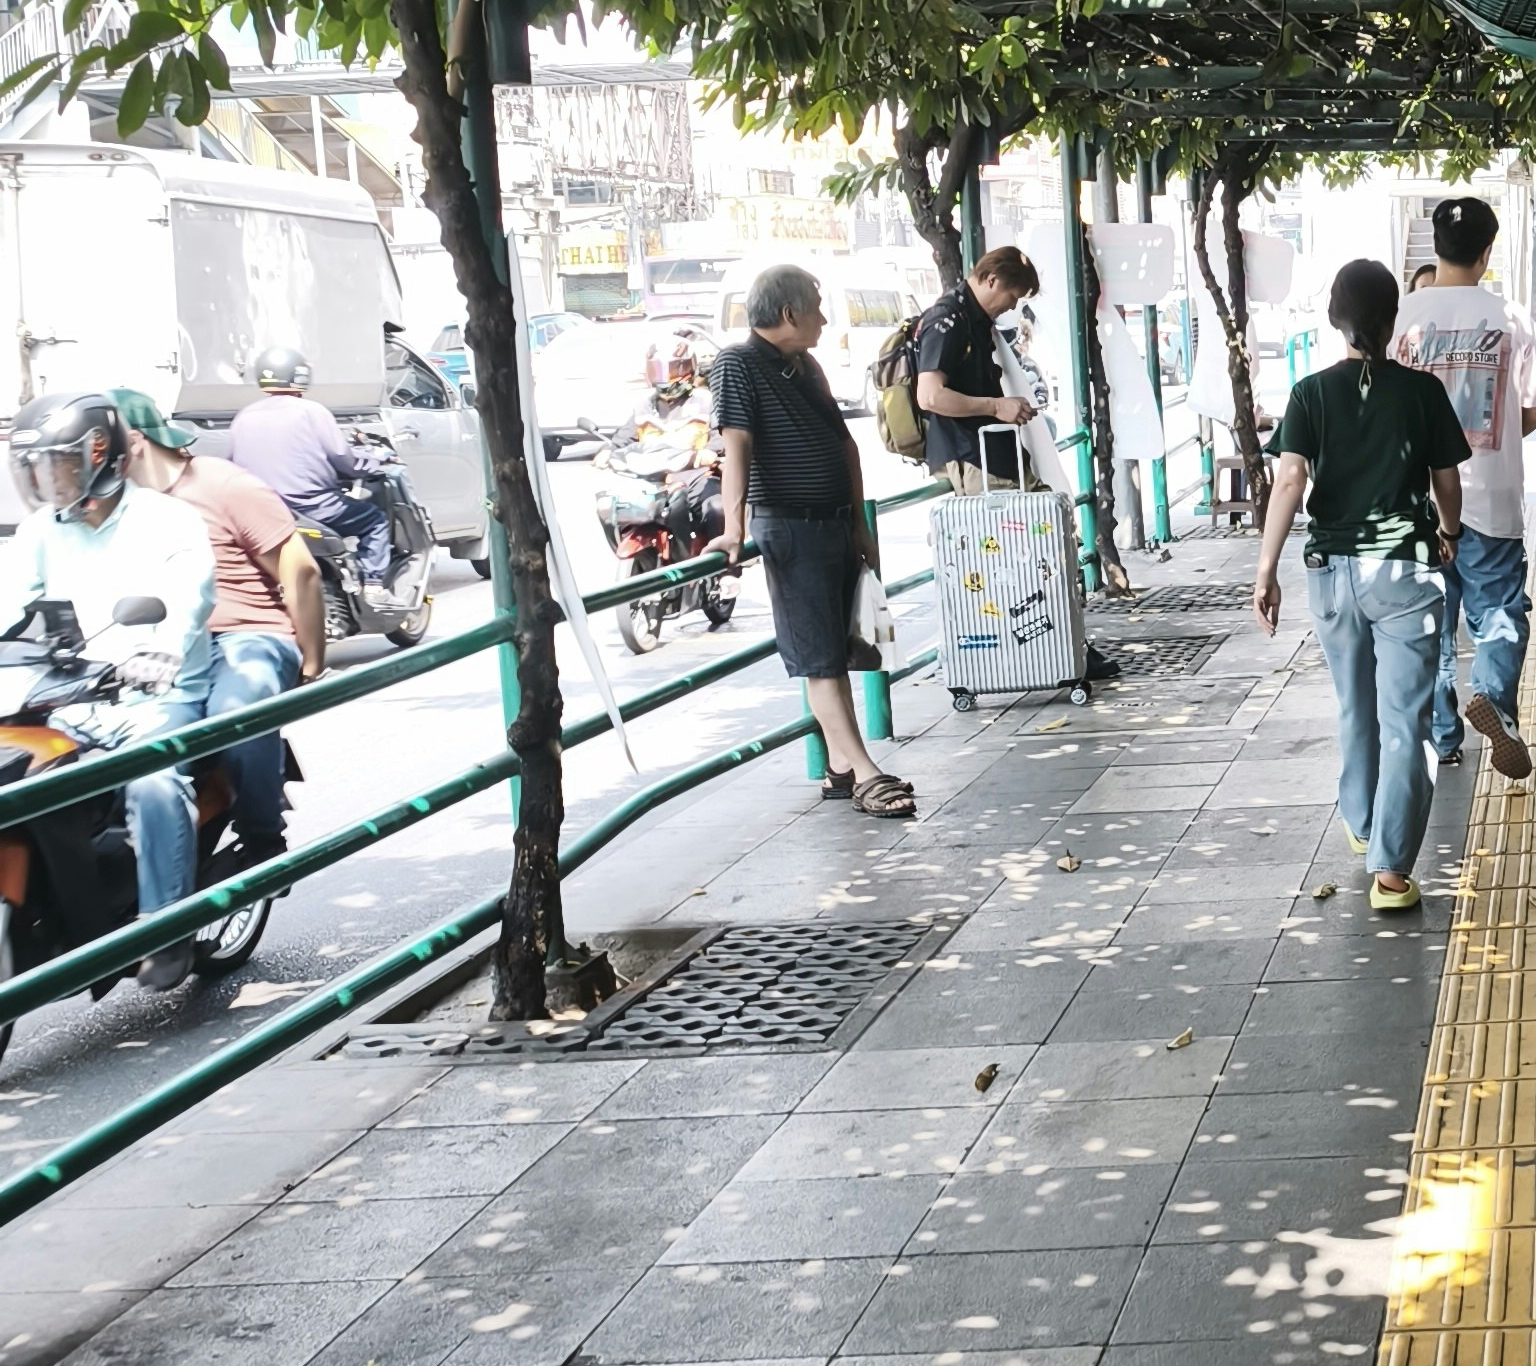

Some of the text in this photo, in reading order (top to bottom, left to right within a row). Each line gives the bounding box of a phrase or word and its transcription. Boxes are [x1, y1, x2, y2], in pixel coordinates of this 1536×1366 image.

[560, 246, 602, 265] THAI
[1446, 352, 1498, 363] RECORD STORE
